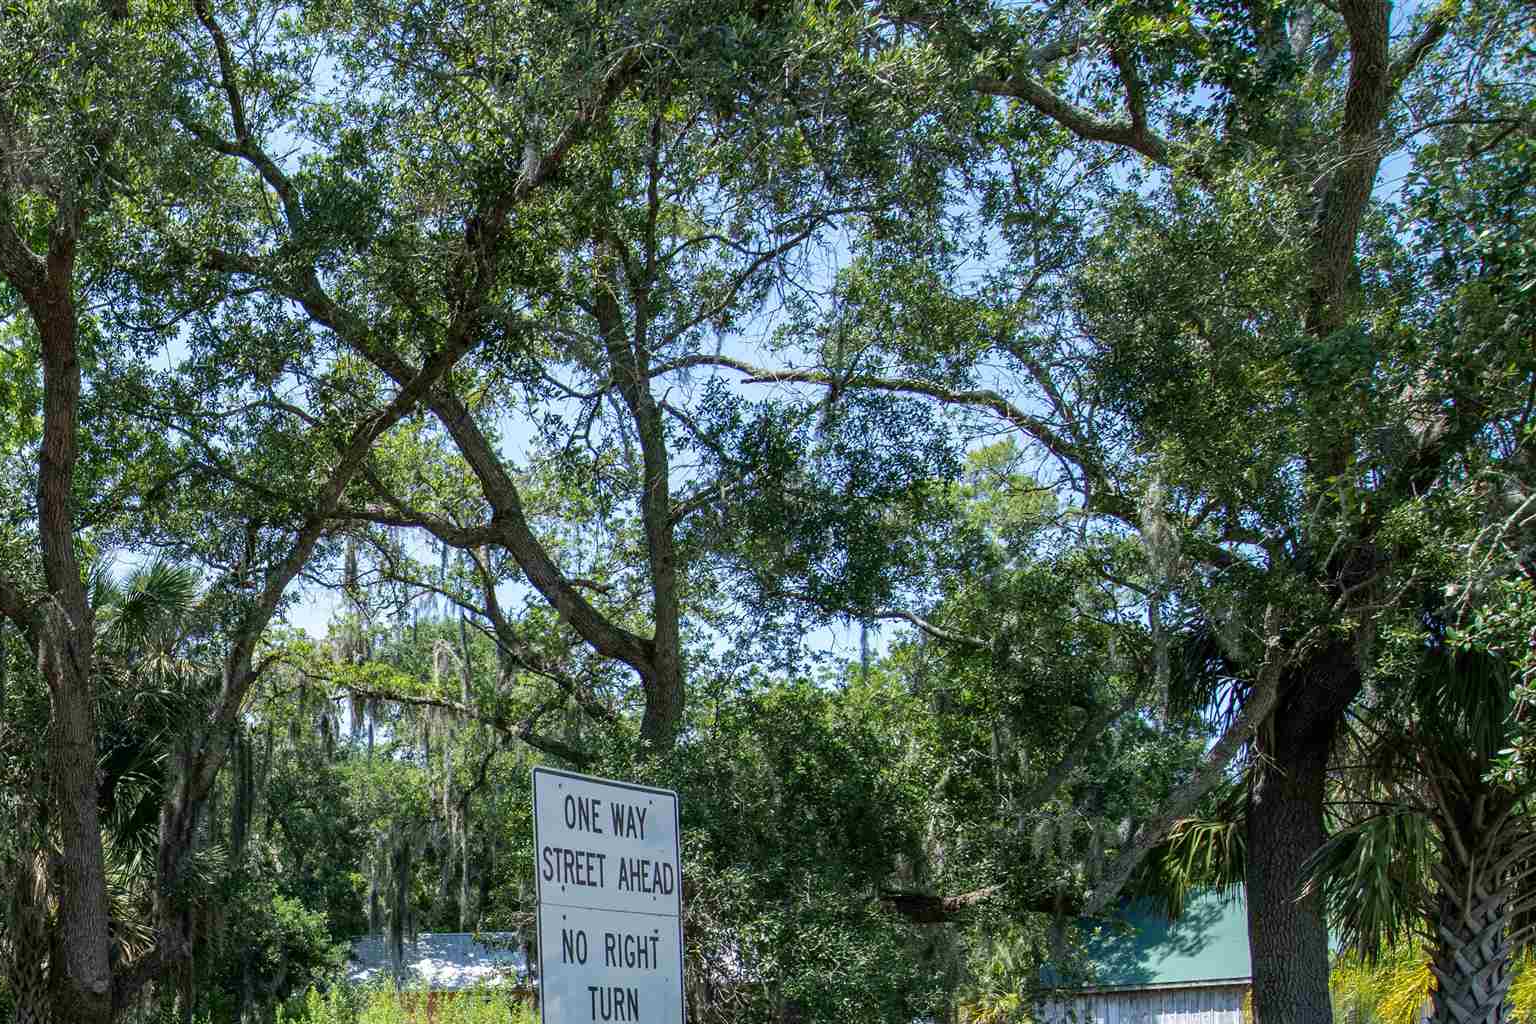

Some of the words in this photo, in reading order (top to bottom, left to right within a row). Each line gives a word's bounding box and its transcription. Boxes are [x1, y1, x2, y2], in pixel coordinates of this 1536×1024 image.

[564, 794, 603, 834] ONE
[611, 802, 648, 841] WAY
[543, 846, 606, 888] STREET
[618, 857, 674, 895] AHEAD
[562, 929, 587, 965] NO
[605, 933, 659, 969] RIGHT
[588, 986, 640, 1022] TURN
